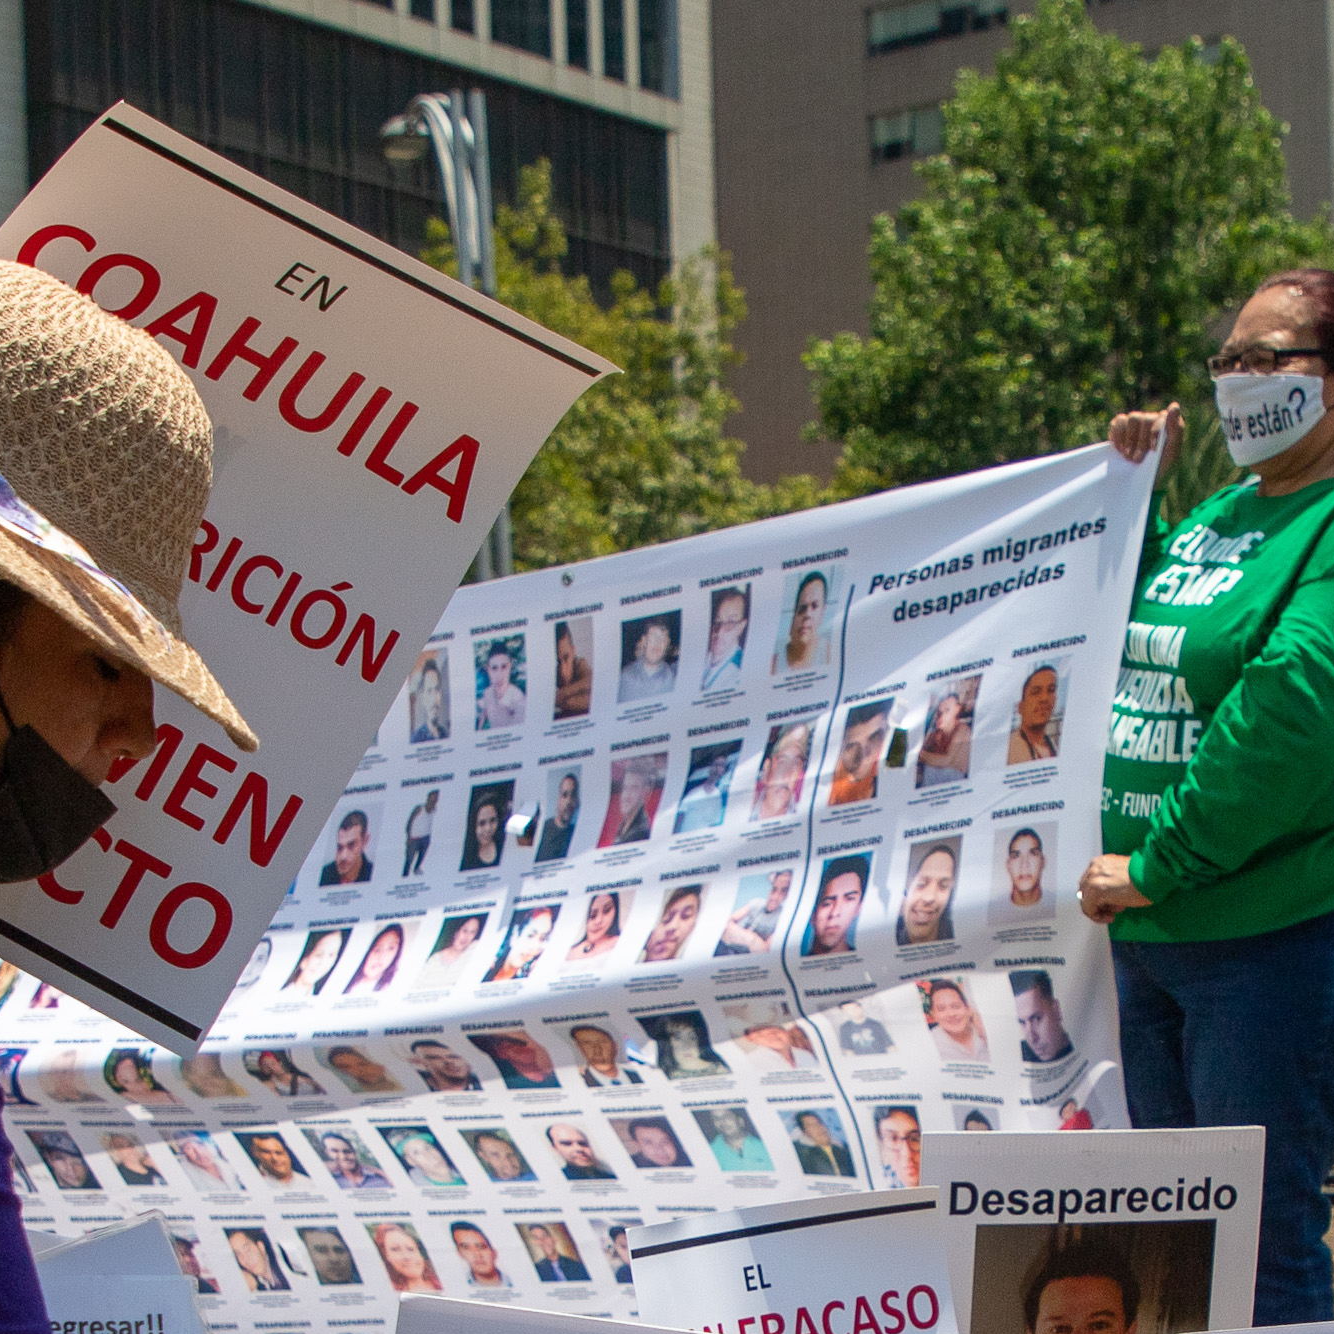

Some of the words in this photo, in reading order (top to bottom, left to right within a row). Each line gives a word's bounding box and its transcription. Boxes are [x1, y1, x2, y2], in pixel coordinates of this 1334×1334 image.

[274, 261, 349, 313] EN
[17, 224, 481, 523] COAHUILA
[869, 549, 974, 596] Personas
[982, 515, 1108, 568] migrantes
[893, 560, 1066, 624] desaparecidas
[948, 1177, 1239, 1223] Desaparecido
[743, 1263, 772, 1292] EL
